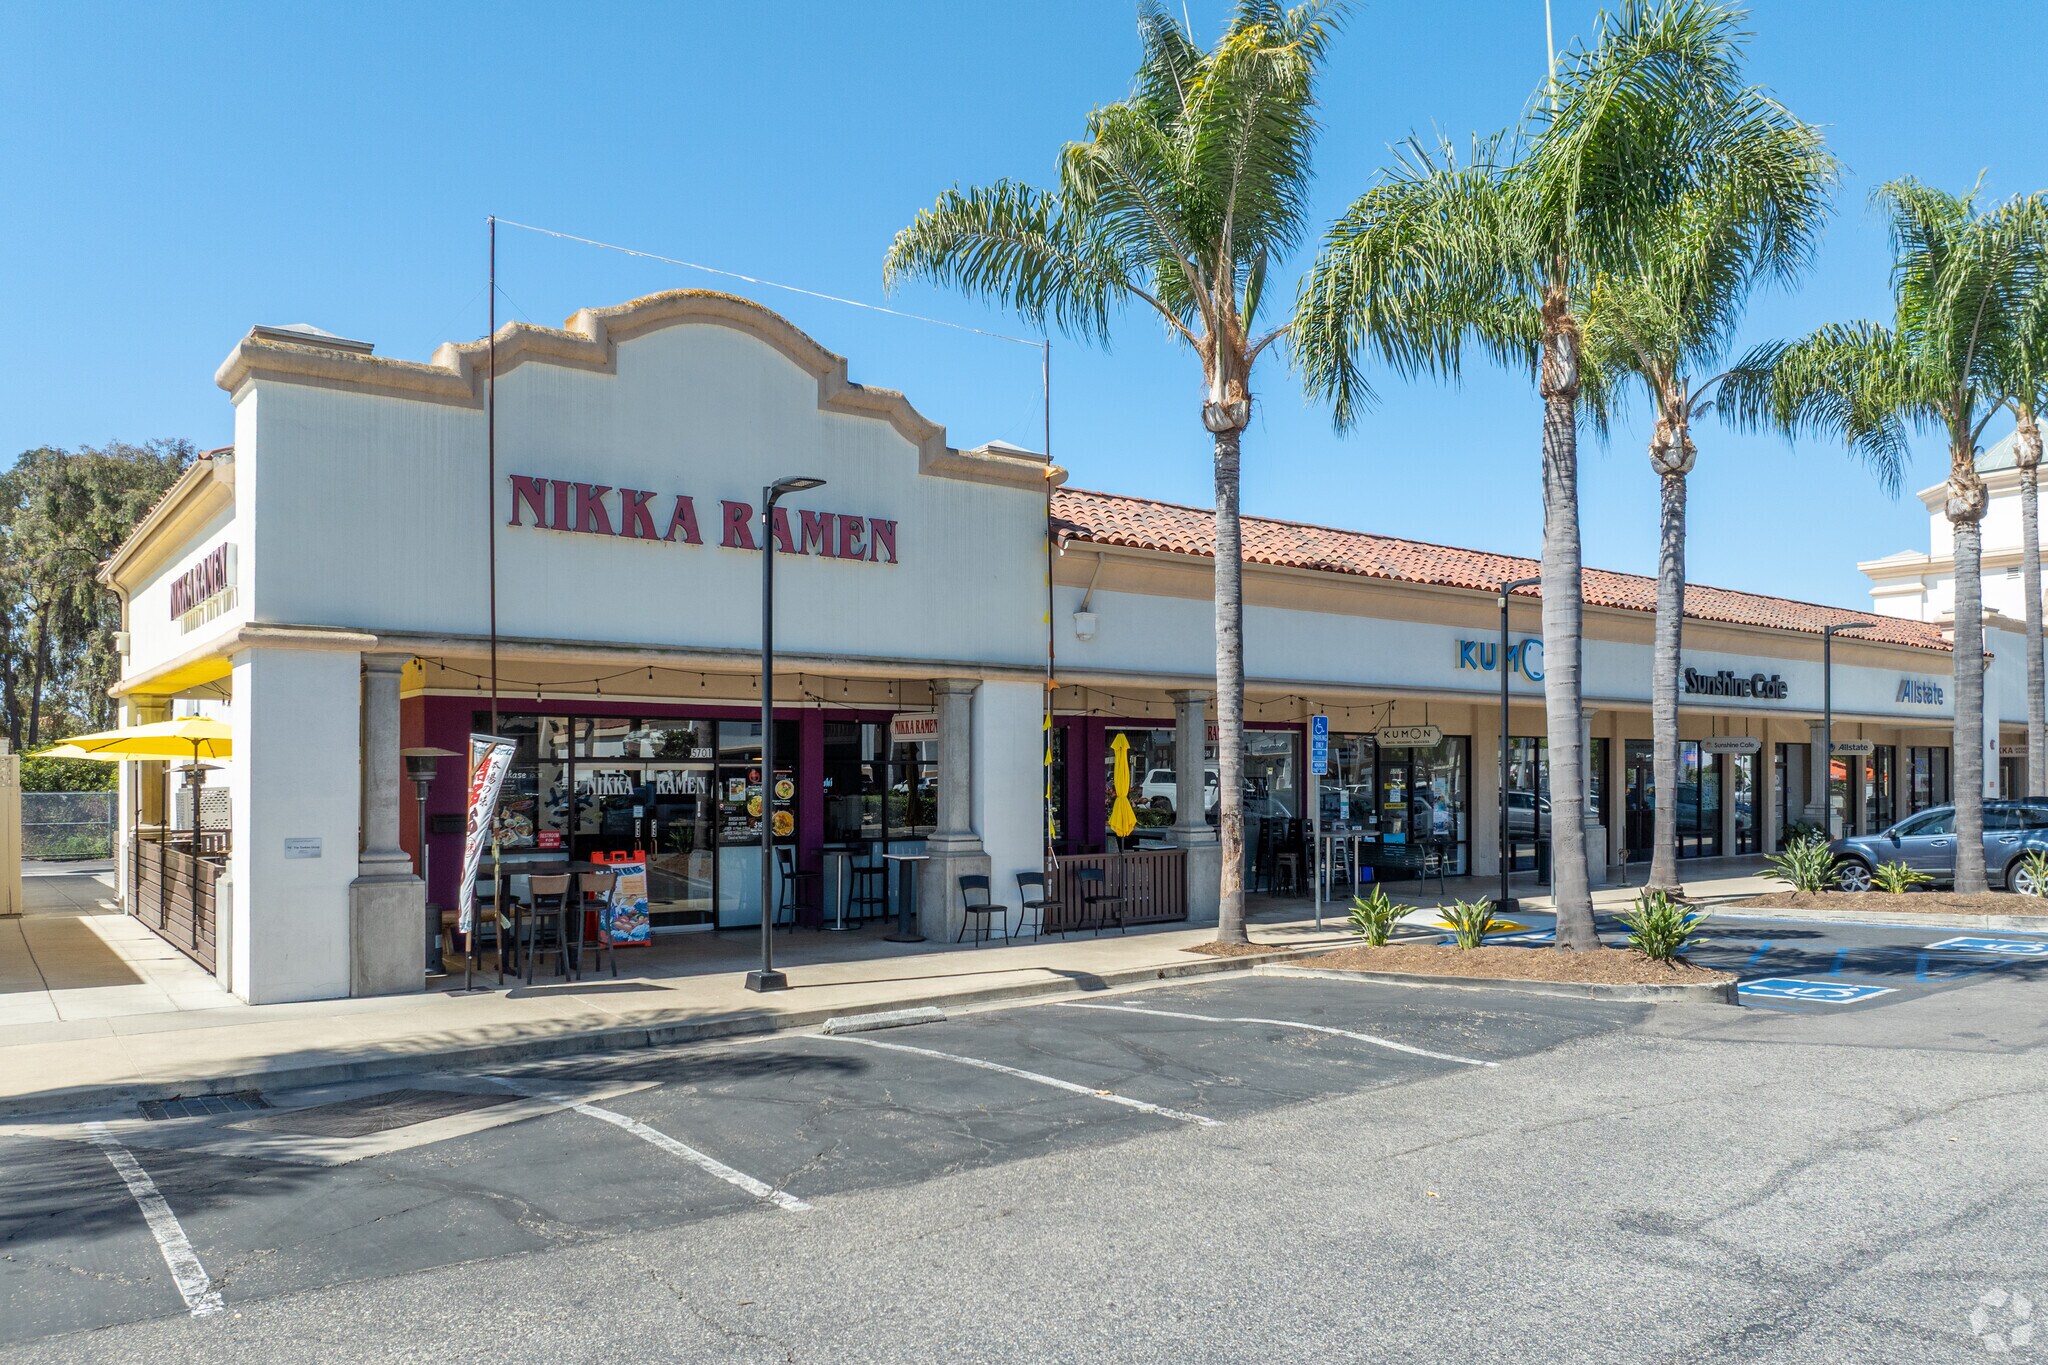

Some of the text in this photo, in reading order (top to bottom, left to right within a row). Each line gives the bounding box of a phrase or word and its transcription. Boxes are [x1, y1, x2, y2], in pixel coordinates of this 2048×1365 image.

[508, 474, 898, 565] NIKKA RAMEN
[170, 542, 228, 621] NIKKA RAMEN
[1456, 639, 1545, 682] KUMO
[1684, 667, 1788, 699] Sunshine Cafe
[1898, 679, 1944, 706] Allstate
[895, 719, 939, 735] NIKKA RAMEN
[1383, 727, 1431, 740] KUMON
[691, 748, 713, 758] 5701
[1838, 743, 1869, 751] Allstate
[586, 776, 706, 795] NIKKA RAMEN
